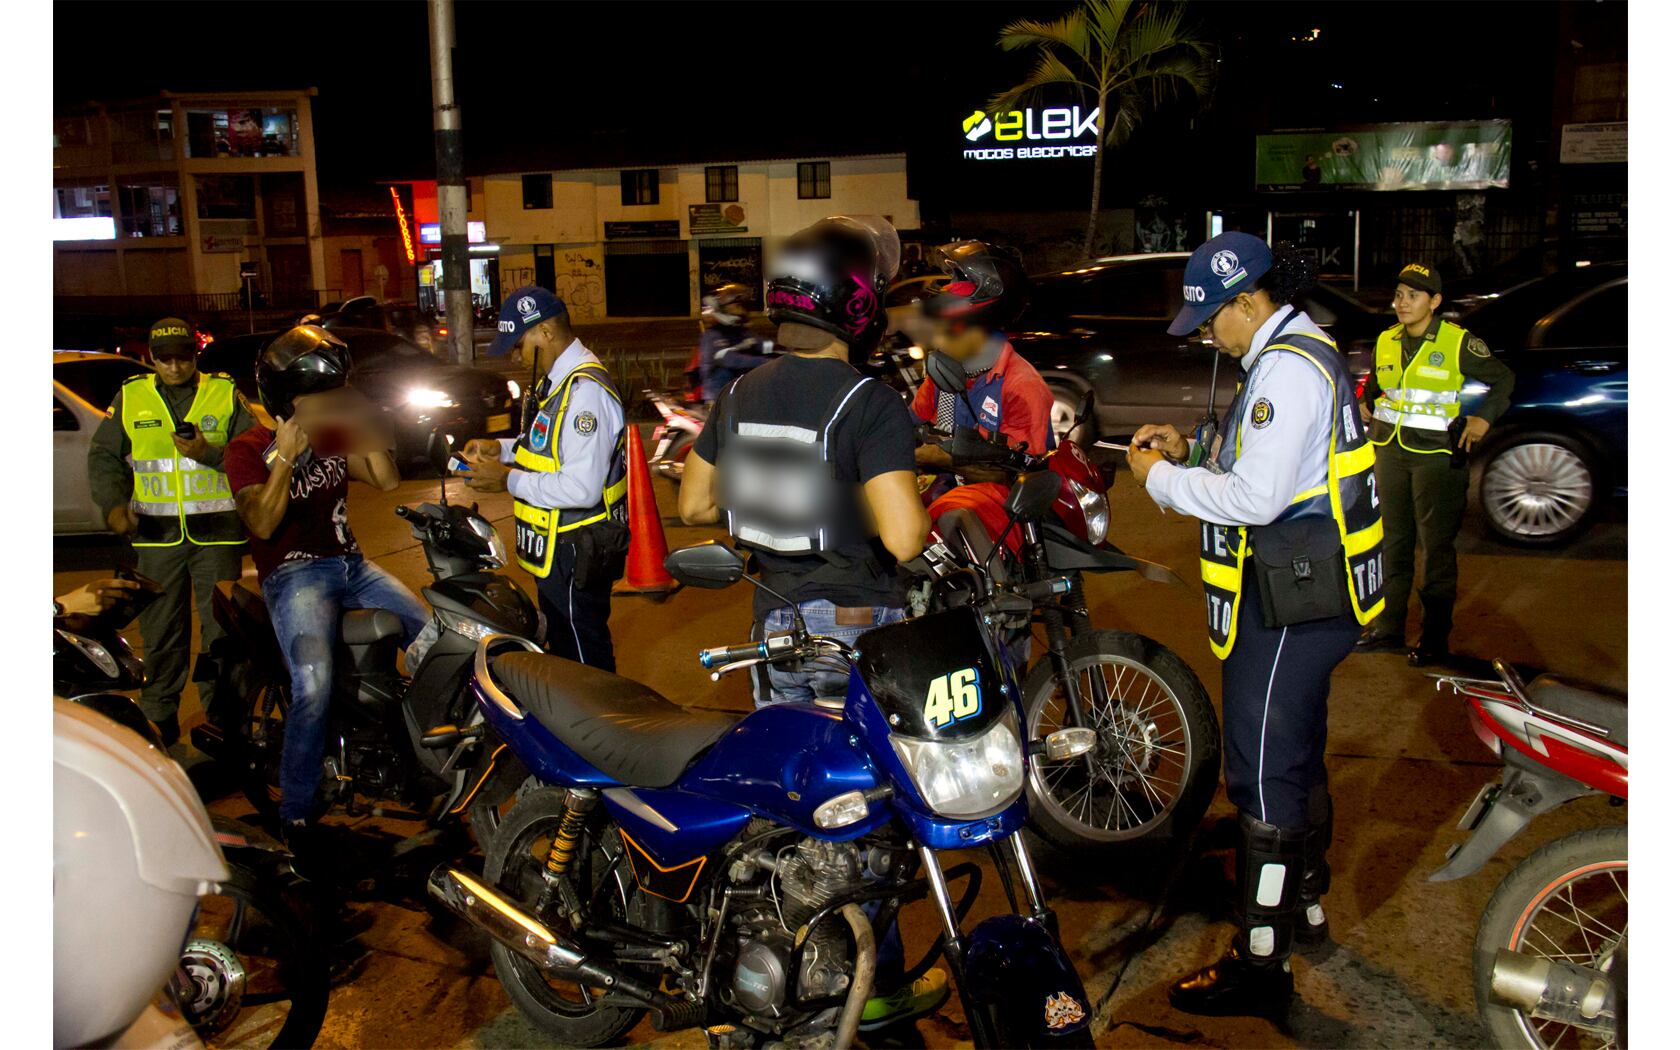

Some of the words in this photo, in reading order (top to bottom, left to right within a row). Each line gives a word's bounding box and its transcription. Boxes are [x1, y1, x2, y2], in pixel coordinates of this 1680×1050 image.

[963, 149, 1014, 160] motos
[151, 327, 188, 340] POLICIA
[141, 473, 229, 497] POLICIA
[923, 666, 983, 730] 46
